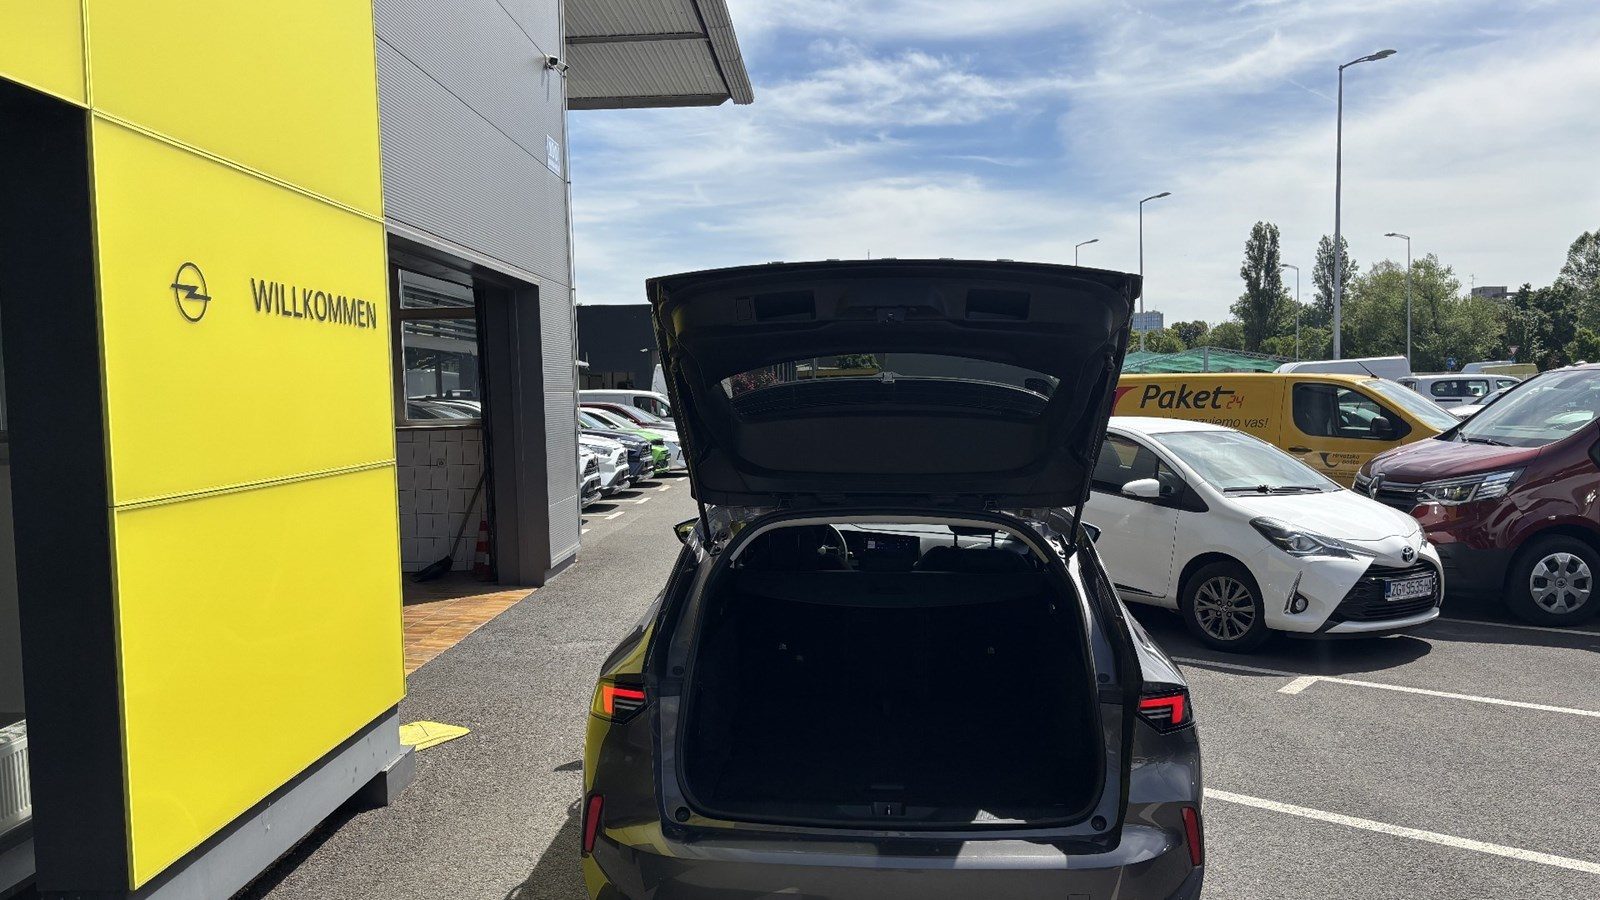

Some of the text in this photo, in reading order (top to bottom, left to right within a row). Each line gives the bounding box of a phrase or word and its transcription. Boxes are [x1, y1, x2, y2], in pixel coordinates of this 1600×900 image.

[250, 277, 377, 330] WILLKOMMEN
[1140, 383, 1245, 410] Paket 24
[1244, 417, 1269, 428] vas!
[1391, 582, 1402, 597] ZG
